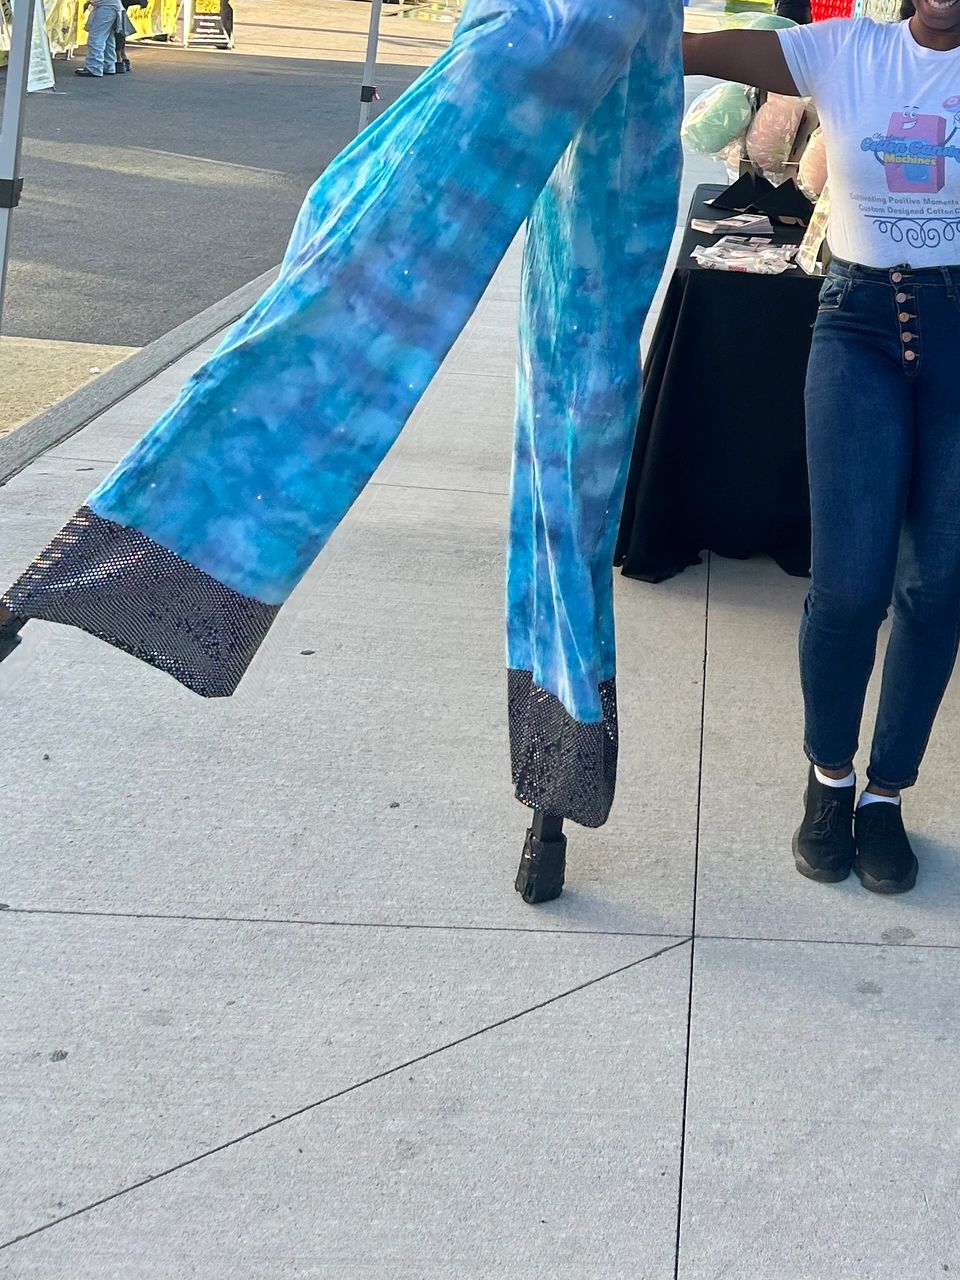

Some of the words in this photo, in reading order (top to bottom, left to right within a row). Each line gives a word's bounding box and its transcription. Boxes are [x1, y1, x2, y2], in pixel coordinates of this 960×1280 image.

[884, 152, 936, 166] Machines
[889, 196, 920, 205] Positive
[859, 204, 885, 213] Custom
[887, 206, 924, 215] Designed
